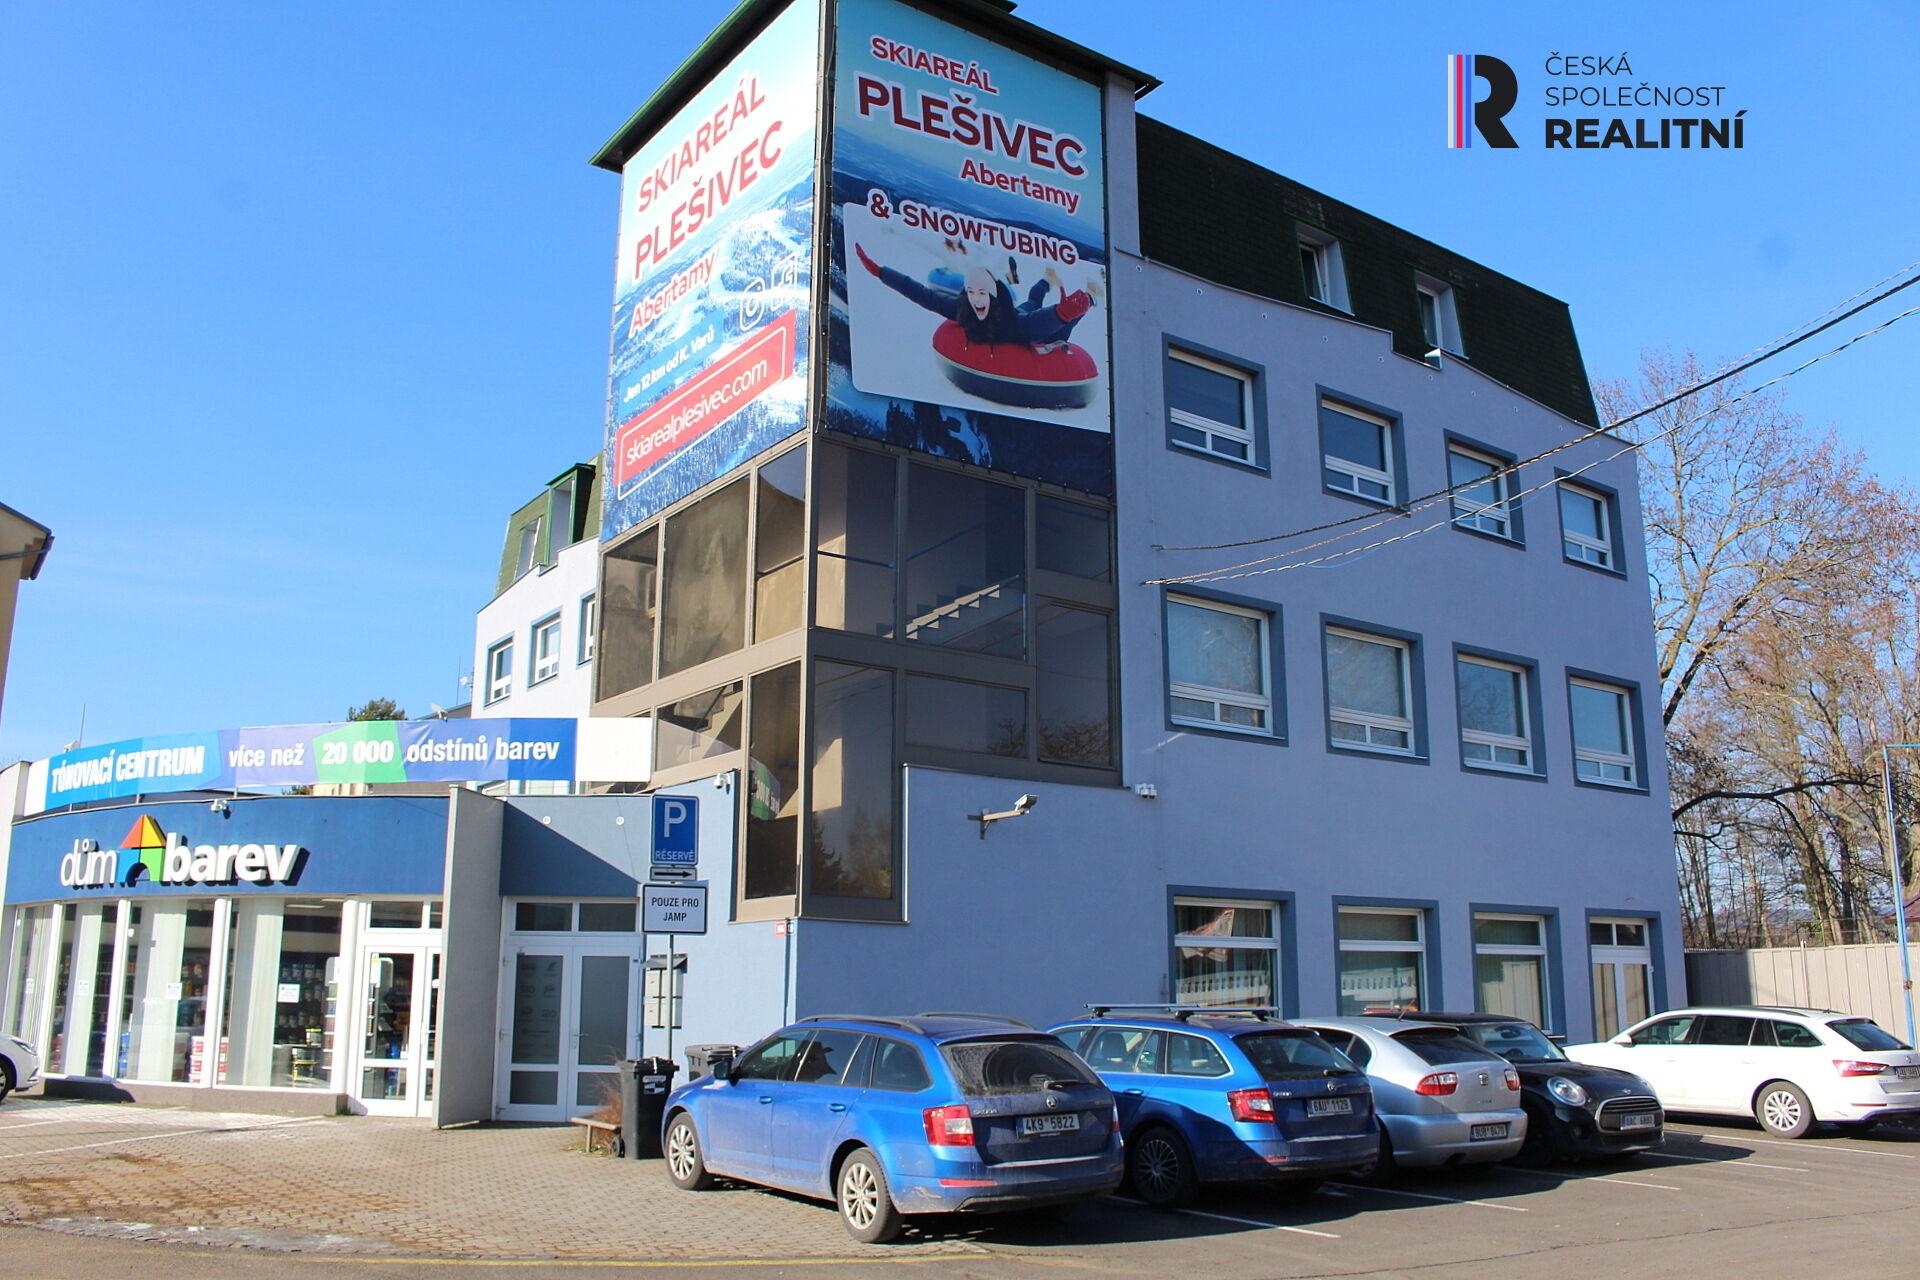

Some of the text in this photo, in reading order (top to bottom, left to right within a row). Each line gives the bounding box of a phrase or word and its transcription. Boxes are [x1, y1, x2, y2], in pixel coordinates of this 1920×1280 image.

[872, 37, 998, 94] SKIAREÁL
[638, 77, 766, 213] SKIAREÁL
[858, 76, 1085, 176] PLEŠIVEC
[635, 120, 783, 280] PLEŠIVEC
[960, 159, 1079, 214] Abertamy
[870, 193, 1077, 266] & SNOWTUBING
[632, 252, 716, 329] Abertamy
[624, 383, 641, 403] Jen
[651, 364, 666, 384] km
[666, 352, 680, 373] od
[626, 359, 768, 467] skiarealplesivec.com
[51, 734, 560, 794] TÓNOVACÍ CENTRUM více než 20 000 odstínů barev
[663, 801, 688, 838] P
[60, 832, 298, 887] dům barev
[655, 848, 696, 862] RÉSERVÉ
[651, 897, 699, 908] POUZE PRO
[662, 912, 687, 922] JAMP
[1025, 1116, 1076, 1132] 4K9 5822
